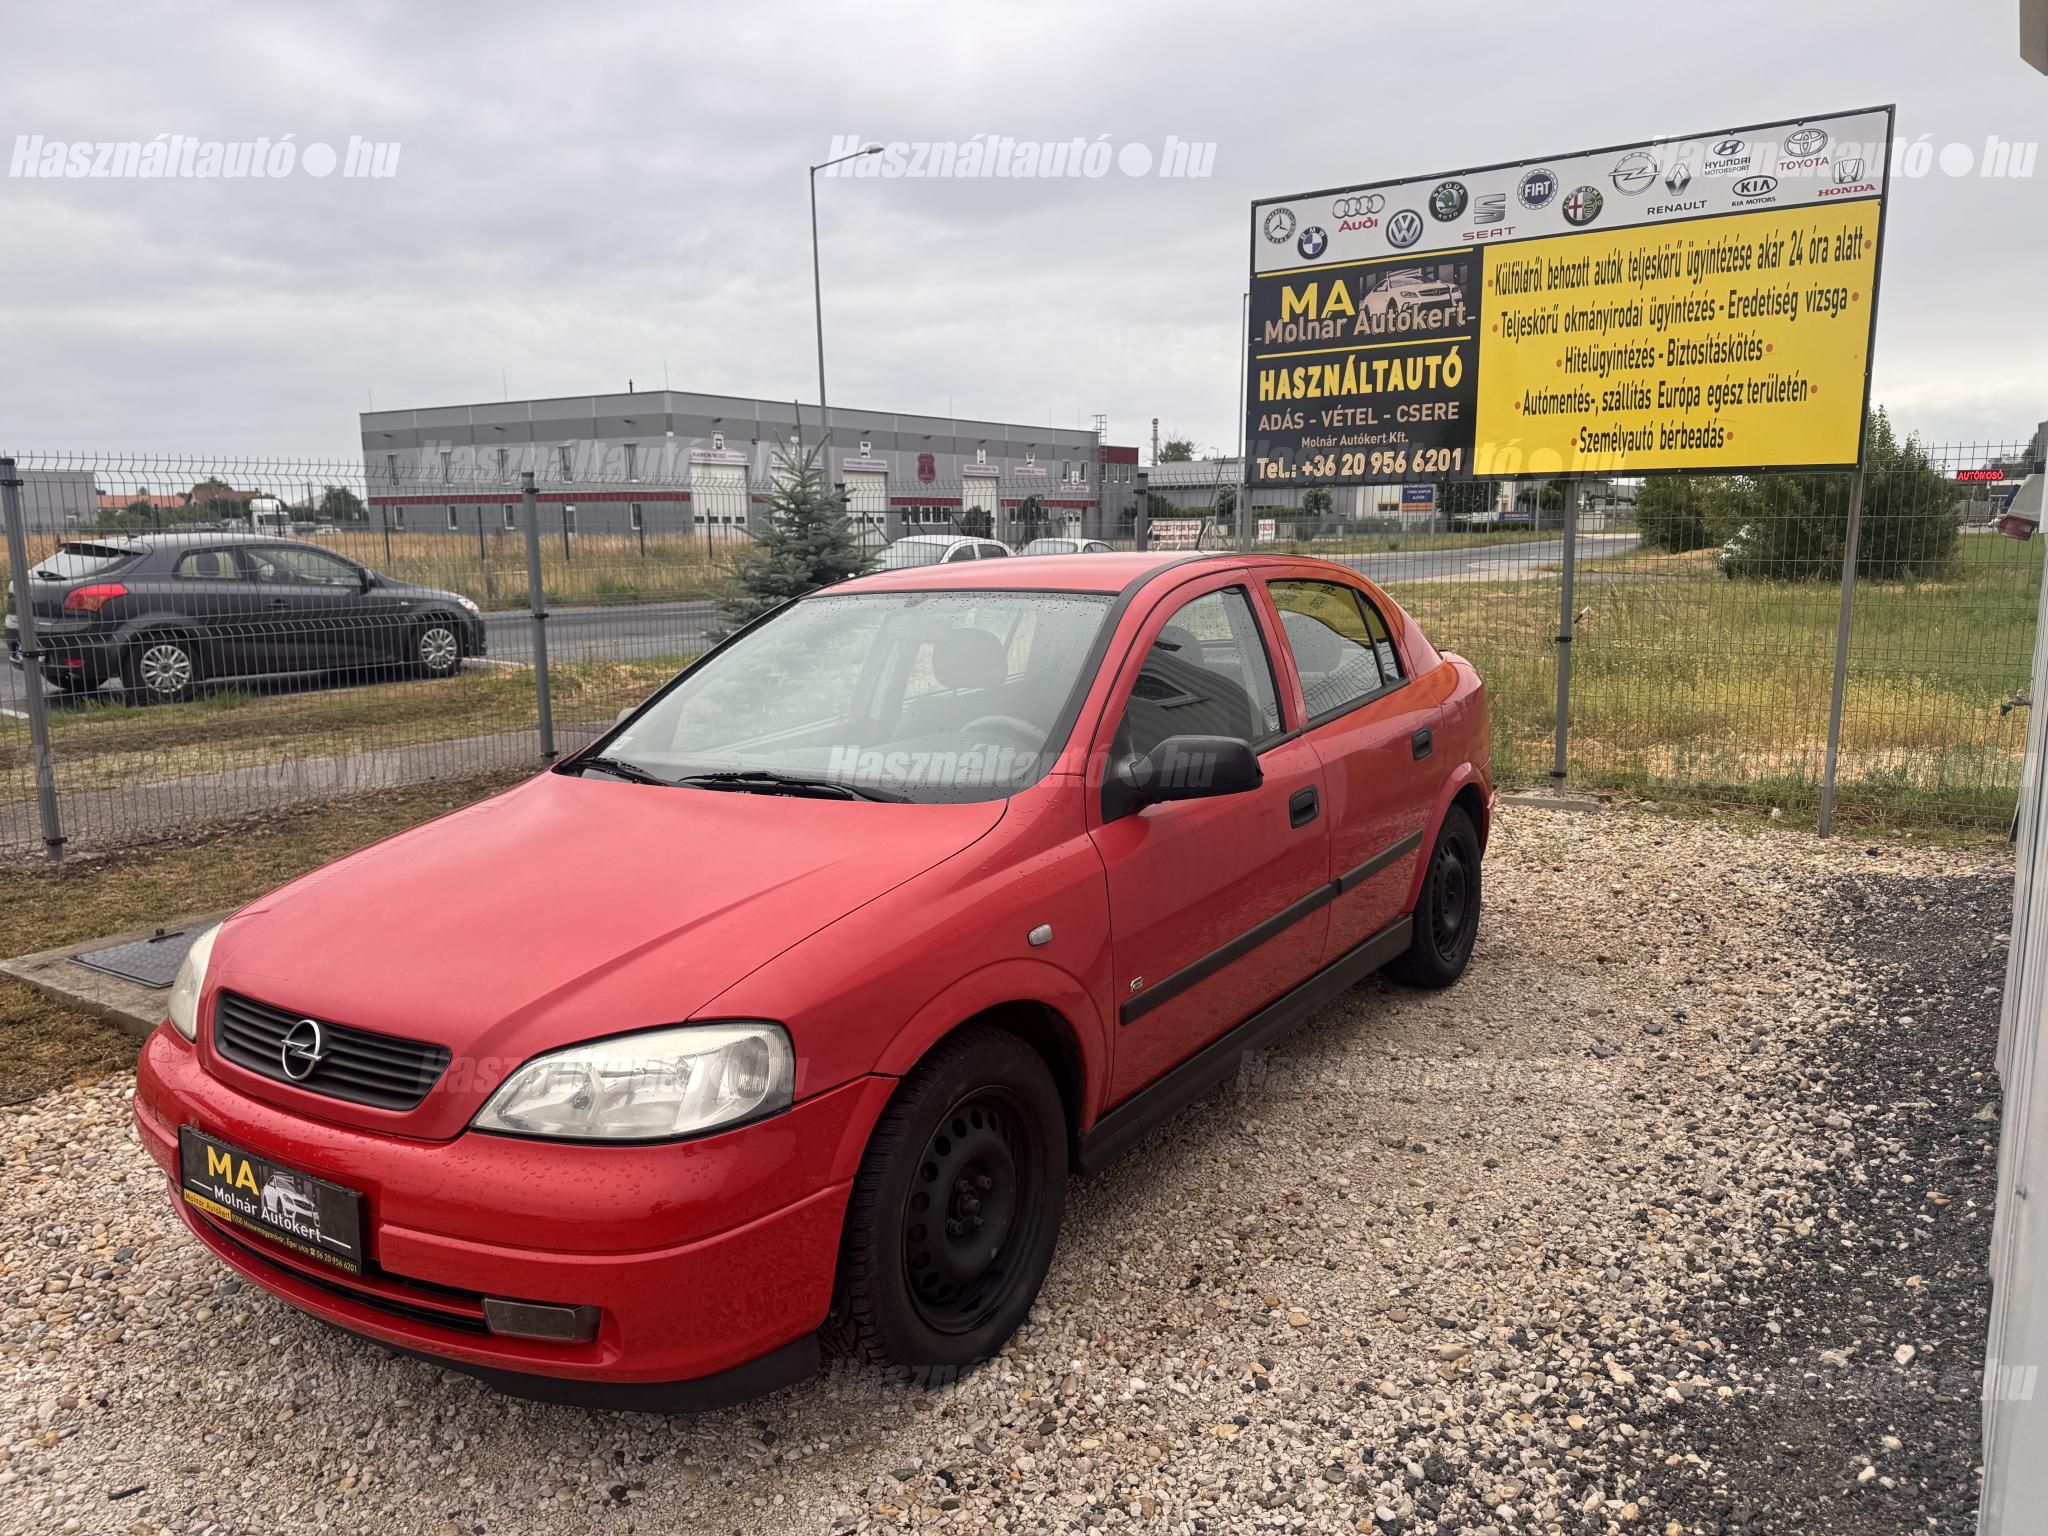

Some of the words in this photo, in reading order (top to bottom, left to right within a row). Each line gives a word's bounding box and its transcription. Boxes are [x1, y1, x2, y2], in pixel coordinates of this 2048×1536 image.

[1704, 166, 1750, 176] MOTORSPORT
[1779, 156, 1829, 171] TOYOTA
[1524, 181, 1551, 198] FIAT
[1740, 179, 1771, 193] KIA
[1817, 183, 1876, 197] HONDA
[1647, 200, 1707, 215] RENAULT
[1745, 196, 1776, 206] MOTORS
[1338, 217, 1378, 232] Audi
[1462, 226, 1516, 241] SEAT
[1495, 256, 1543, 296] Külföldről
[1547, 256, 1590, 291] behozott
[1594, 248, 1624, 286] autók
[1628, 240, 1683, 290] teljeskörű
[1687, 234, 1751, 285] ügyintézése
[1757, 229, 1785, 269] akár
[1789, 229, 1804, 267] 24
[1809, 225, 1829, 264] óra
[1834, 225, 1863, 262] alatt
[1281, 279, 1356, 323] MA
[1501, 304, 1559, 344] Teljeskörű
[1564, 298, 1644, 336] okmányirodai
[1650, 289, 1716, 332] ügyintézés
[1727, 282, 1799, 322] Eredetiség
[1806, 282, 1848, 319] vizsga
[1565, 338, 1655, 378] Hitelügyintézés
[1667, 330, 1764, 367] Biztosításkötés
[1259, 345, 1463, 402] HASZNÁLTAUTÓ
[1602, 379, 1652, 412] szállítás
[1657, 376, 1700, 414] Európa
[1707, 374, 1744, 413] egész
[1747, 370, 1808, 405] területén
[1258, 408, 1305, 432] ADÁS
[1321, 404, 1378, 428] VÉTEL
[1396, 401, 1460, 423] CSERE
[1301, 435, 1337, 449] Molnár
[1340, 432, 1386, 446] Autókert
[1389, 431, 1409, 444] Kft.
[1579, 420, 1653, 459] Személyautó
[1659, 418, 1725, 451] bérbeadás
[1256, 457, 1297, 480] Tel.:
[1302, 454, 1336, 478] +36
[1341, 452, 1365, 477] 20
[1370, 450, 1407, 475] 956
[1412, 447, 1462, 473] 6201
[1958, 469, 2003, 480] AUTÓMOSÓ
[207, 1145, 260, 1196] MA
[214, 1185, 257, 1215] Molnár
[332, 1256, 343, 1267] 956
[343, 1261, 357, 1273] 6201
